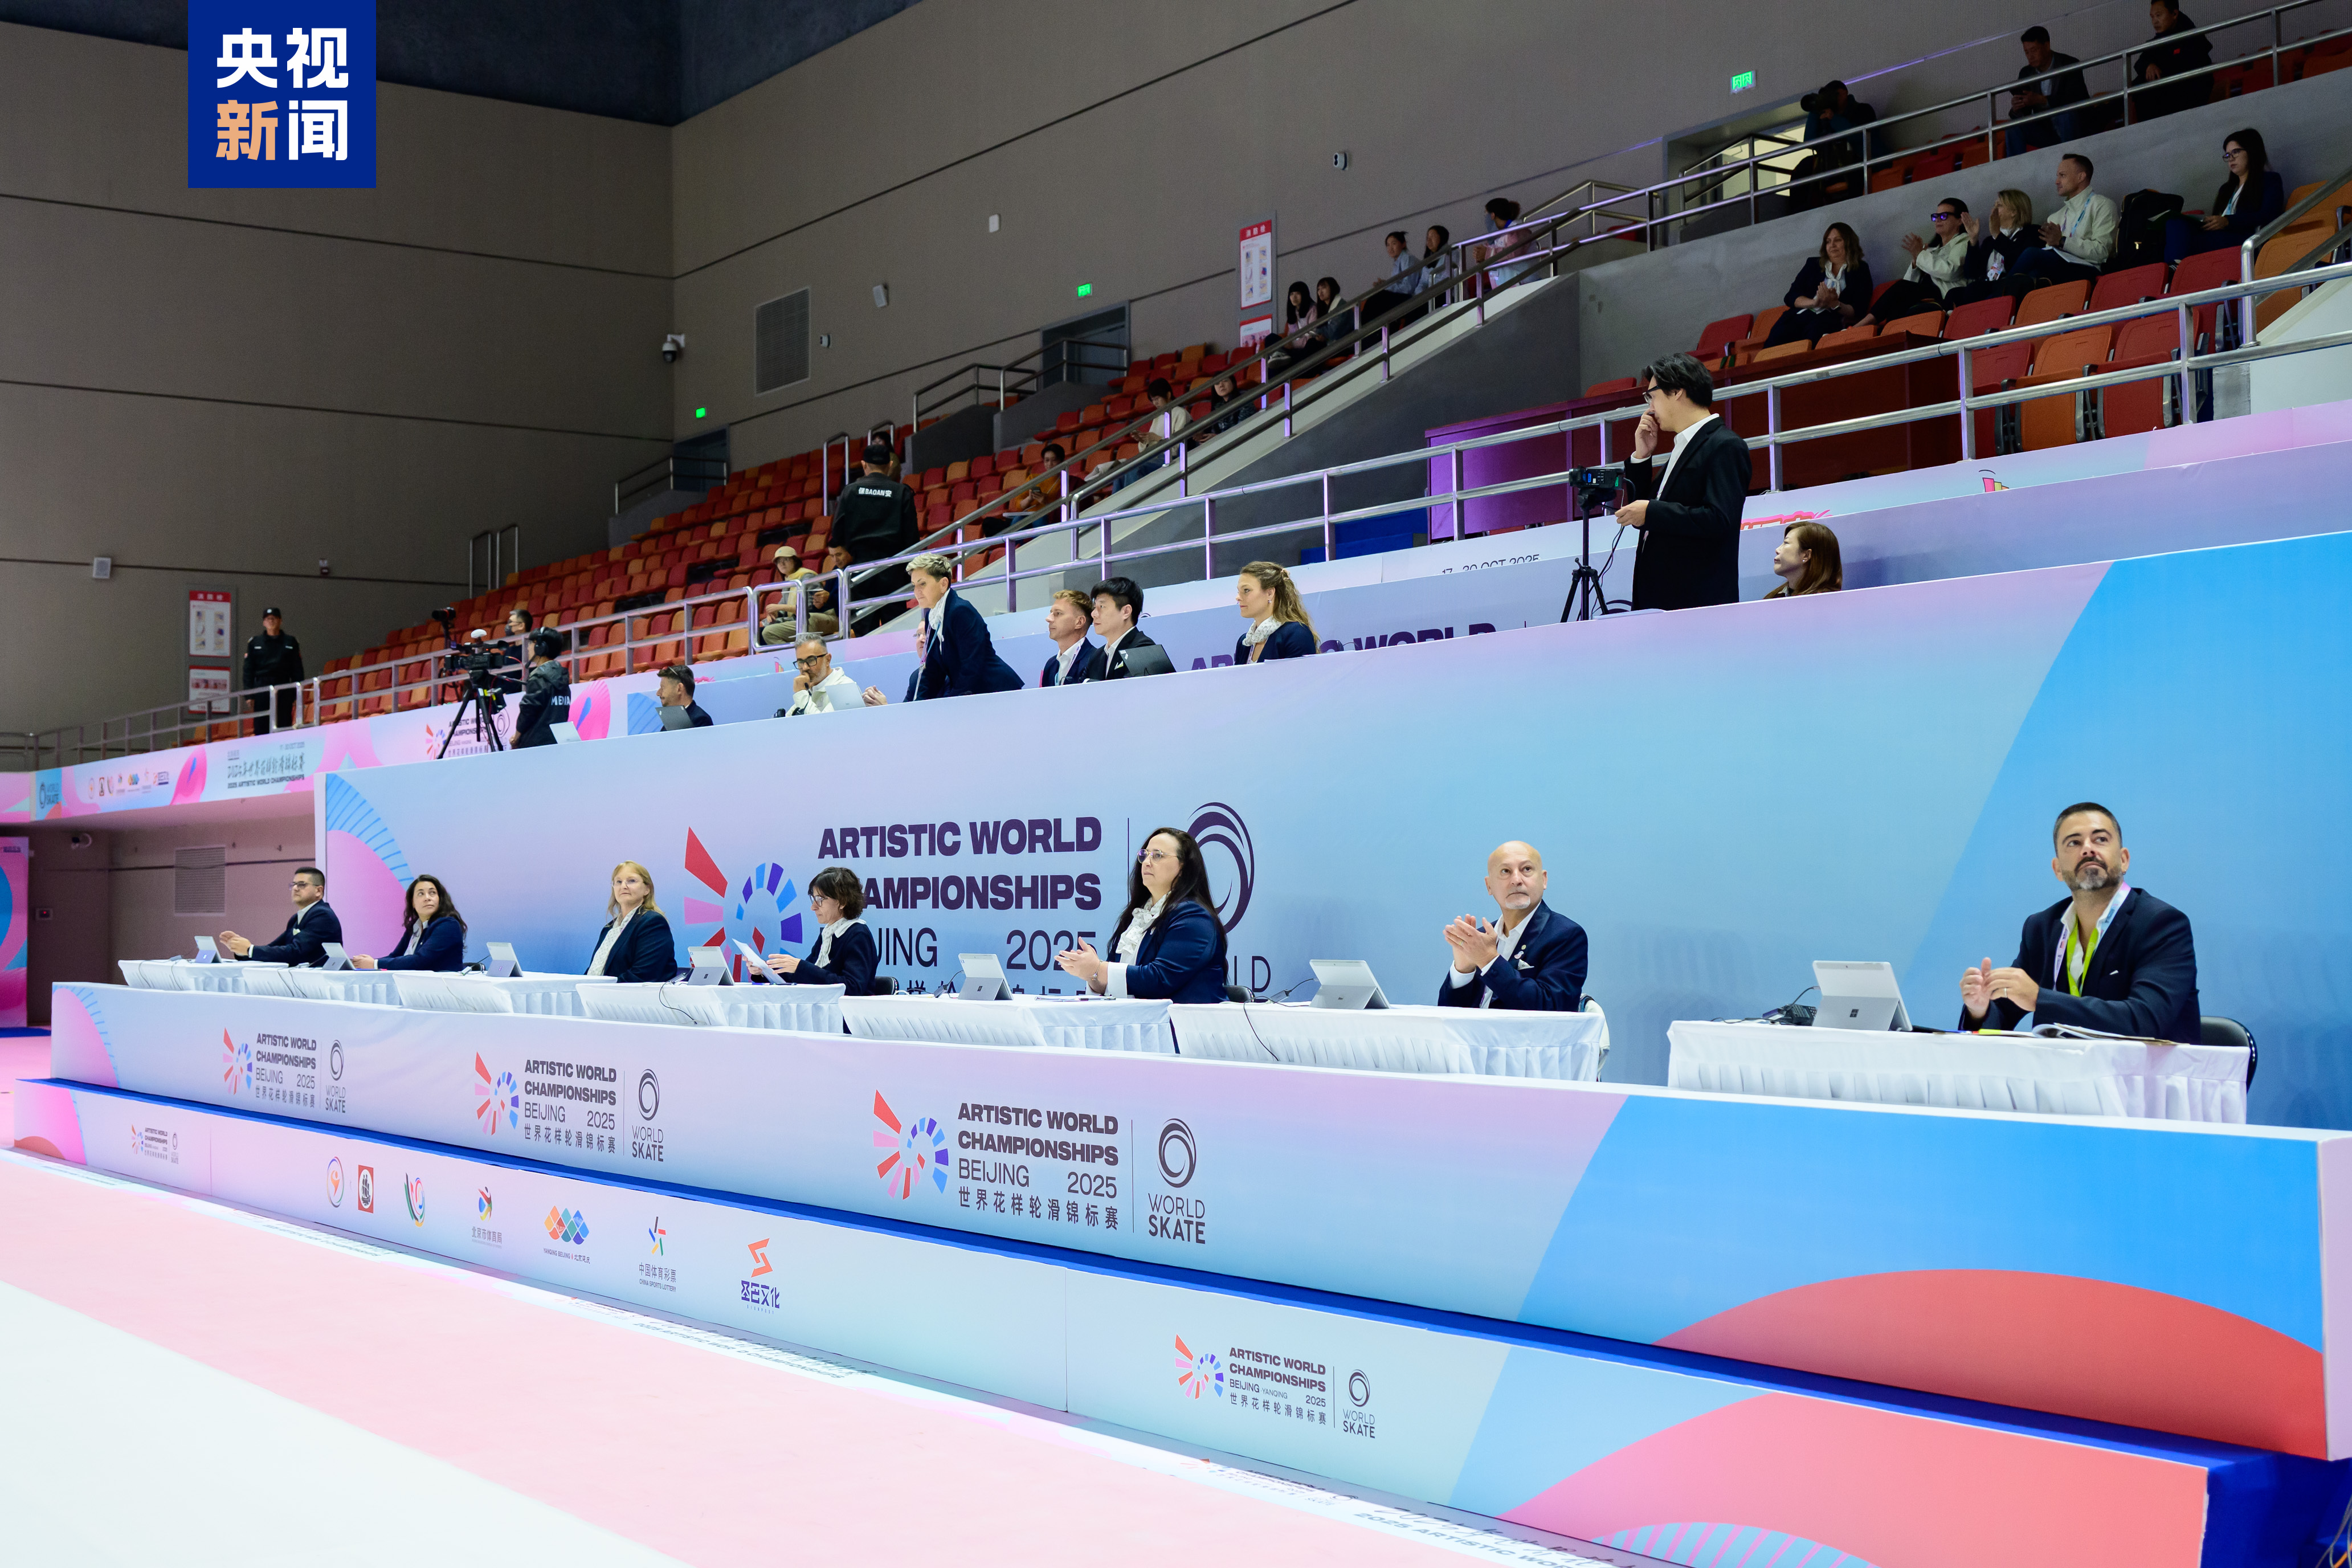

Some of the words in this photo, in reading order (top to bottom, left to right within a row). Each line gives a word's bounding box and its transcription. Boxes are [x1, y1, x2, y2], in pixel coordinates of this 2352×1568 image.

[551, 695, 570, 705] MEDIA
[818, 822, 961, 859] ARTISTIC
[969, 816, 1102, 855] WORLD
[863, 873, 1102, 910] AMPIONSHIPS
[256, 1033, 289, 1048] ARTISTIC
[291, 1037, 317, 1051] WORLD
[256, 1050, 316, 1069] CHAMPIONSHIPS
[525, 1060, 573, 1077] ARTISTIC
[576, 1064, 616, 1083] WORLD
[256, 1067, 283, 1084] BEIJING
[296, 1073, 315, 1089] 2025
[325, 1084, 346, 1099] WORLD
[325, 1097, 346, 1113] SKATE
[524, 1081, 616, 1106] CHAMPIONSHIPS
[524, 1101, 566, 1123] BEIJING
[587, 1110, 615, 1130] 2025
[958, 1102, 1042, 1128] ARTISTIC
[1046, 1110, 1118, 1135] WORLD
[524, 1123, 615, 1154] 世界花样轮滑锦标赛
[632, 1125, 664, 1144] WORLD
[958, 1130, 1119, 1166] CHAMPIONSHIPS
[632, 1141, 664, 1162] SKATE
[959, 1157, 1030, 1187] BEIJING
[1067, 1171, 1117, 1199] 2025
[958, 1186, 1118, 1231] 世界花样轮滑锦标赛
[1148, 1192, 1206, 1219] WORLD
[472, 1226, 502, 1244] 北京市体育局
[1148, 1214, 1206, 1245] SKATE
[639, 1262, 676, 1283] 中国体育彩票
[649, 1281, 662, 1289] SPORTS
[662, 1284, 676, 1292] LOTTERY
[741, 1280, 780, 1309] 圣巴文化
[1229, 1347, 1281, 1366] ARTISTIC
[1283, 1357, 1326, 1375] WORLD
[1229, 1363, 1326, 1393] CHAMPIONSHIPS
[1230, 1378, 1260, 1393] BEIJING
[1305, 1395, 1326, 1407] 2025
[1230, 1392, 1326, 1426] 世界花样轮滑锦标赛
[1342, 1408, 1375, 1425] WORLD
[1343, 1420, 1375, 1439] SKATE
[1353, 1513, 1412, 1529] 2025
[1412, 1529, 1516, 1555] ARTISTIC
